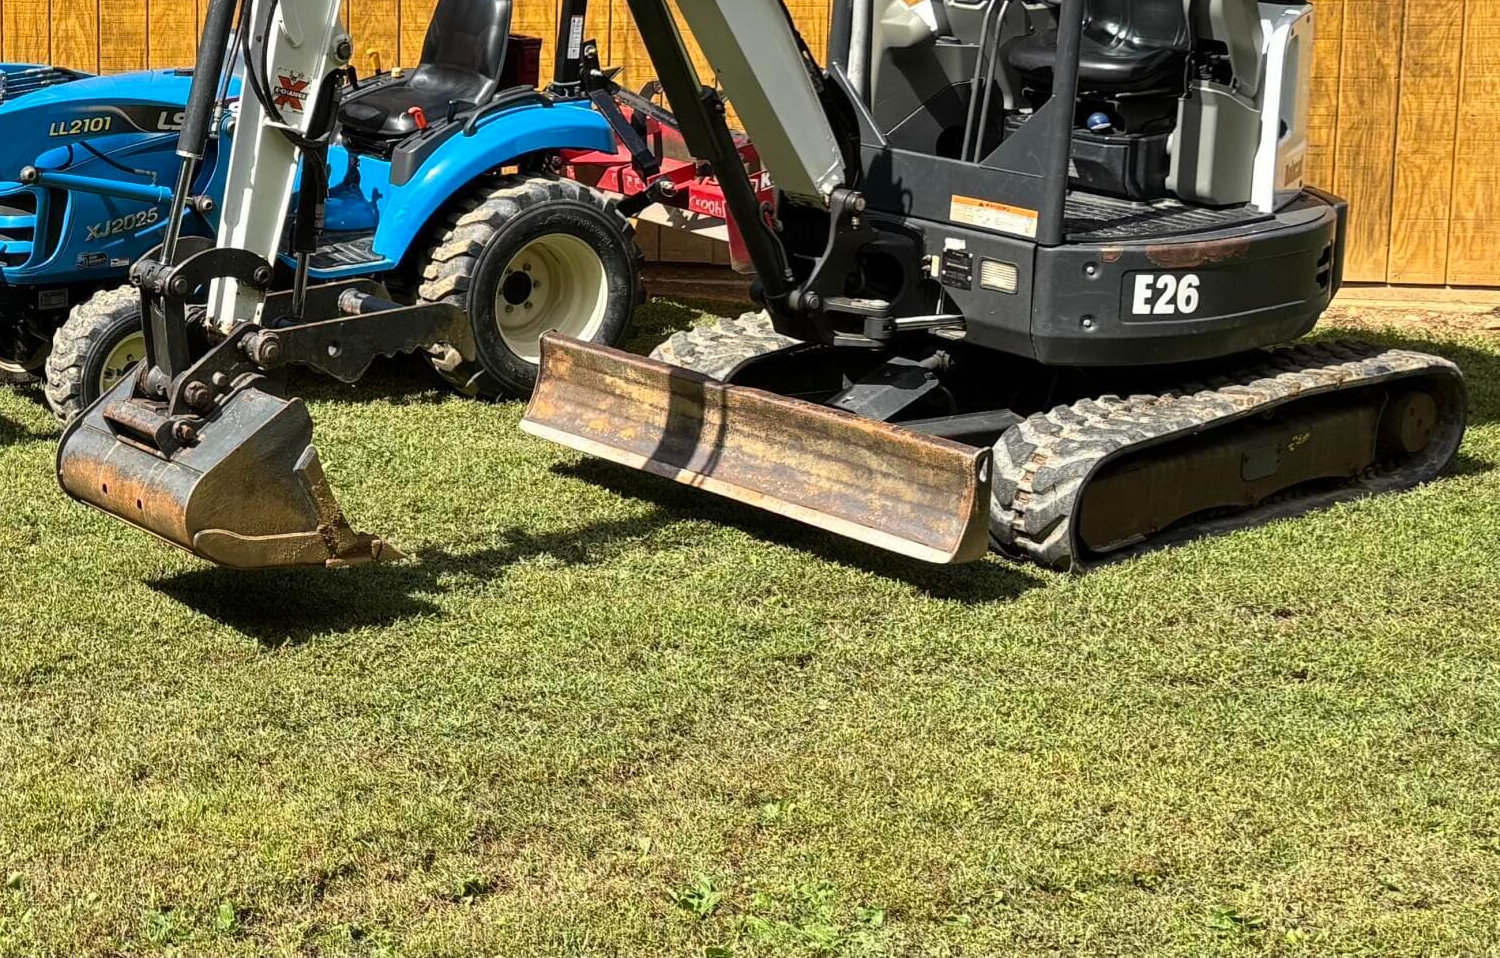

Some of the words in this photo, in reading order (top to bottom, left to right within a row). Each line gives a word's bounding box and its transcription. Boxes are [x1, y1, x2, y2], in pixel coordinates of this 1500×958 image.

[49, 116, 112, 136] LL2101
[84, 206, 159, 242] XJ2025
[1132, 273, 1200, 314] E26
